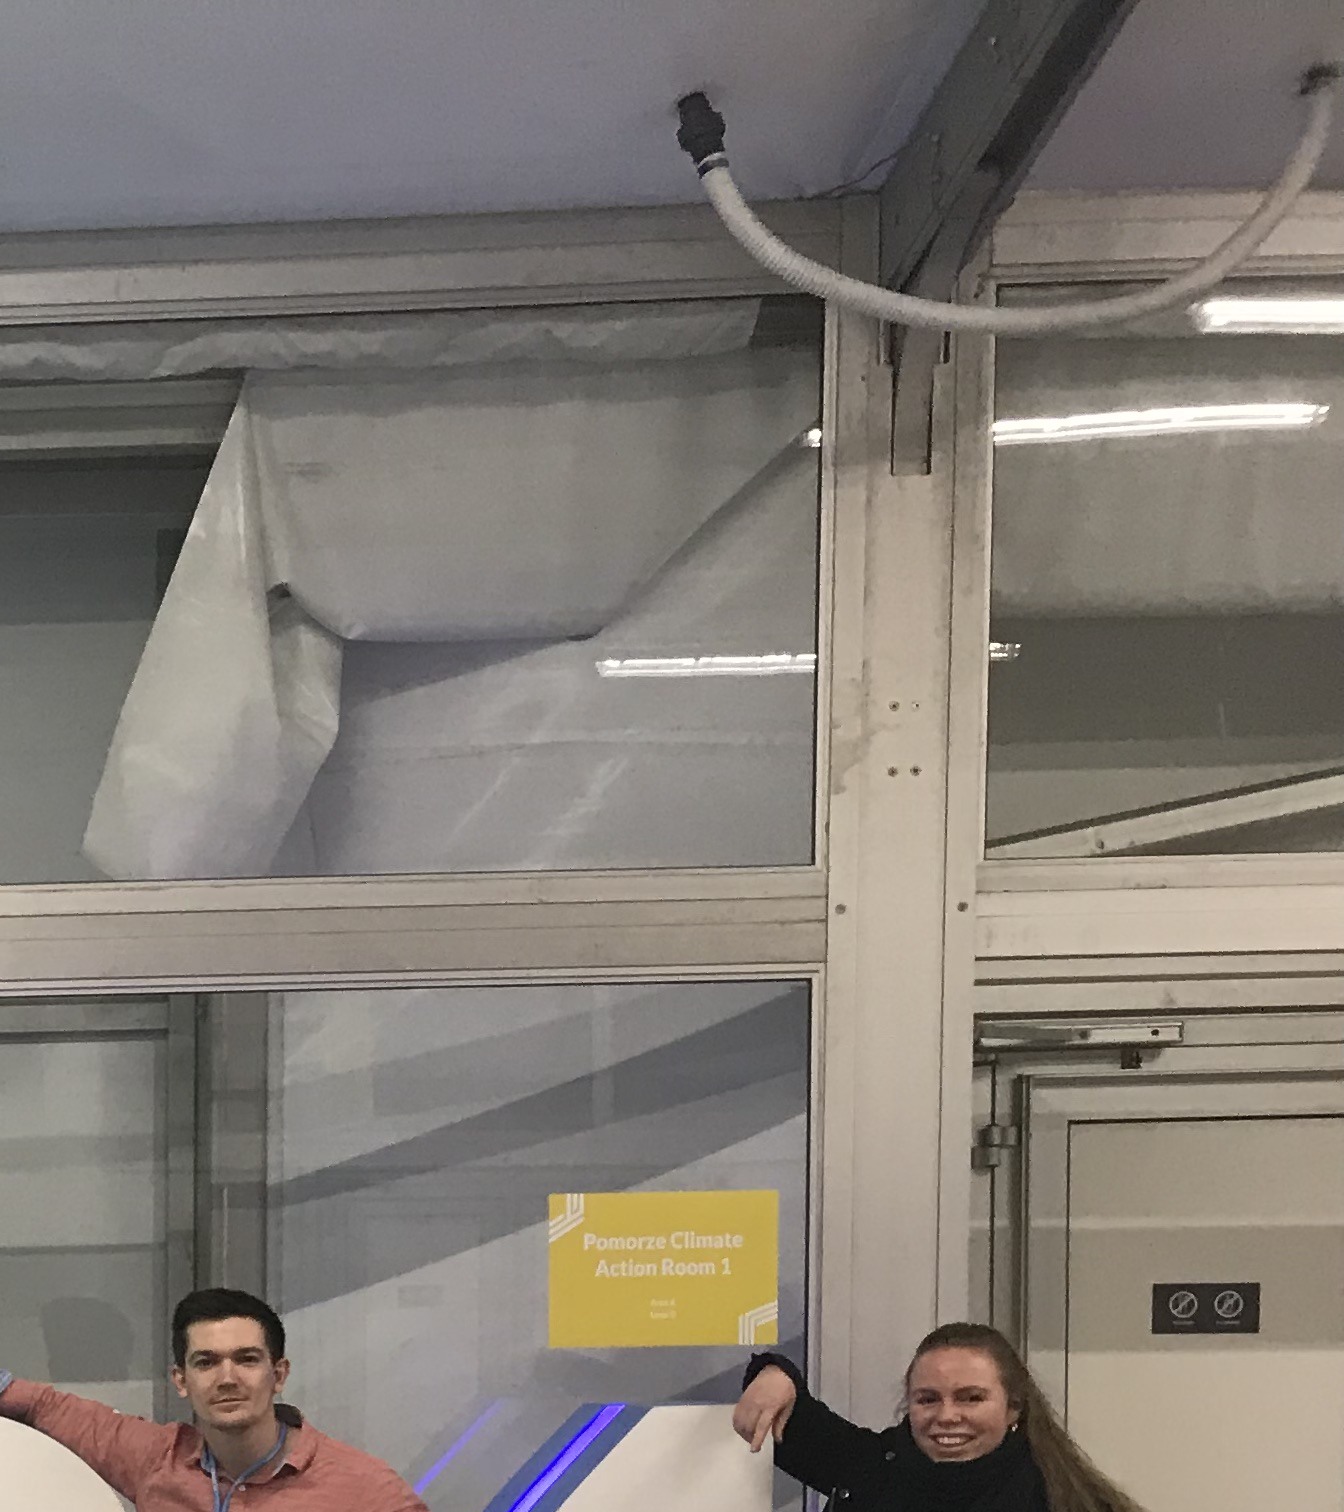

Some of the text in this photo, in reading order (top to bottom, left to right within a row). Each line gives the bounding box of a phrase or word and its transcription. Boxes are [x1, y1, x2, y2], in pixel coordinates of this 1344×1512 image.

[583, 1230, 744, 1251] Pomorze Climate
[595, 1256, 732, 1278] Action Room 1
